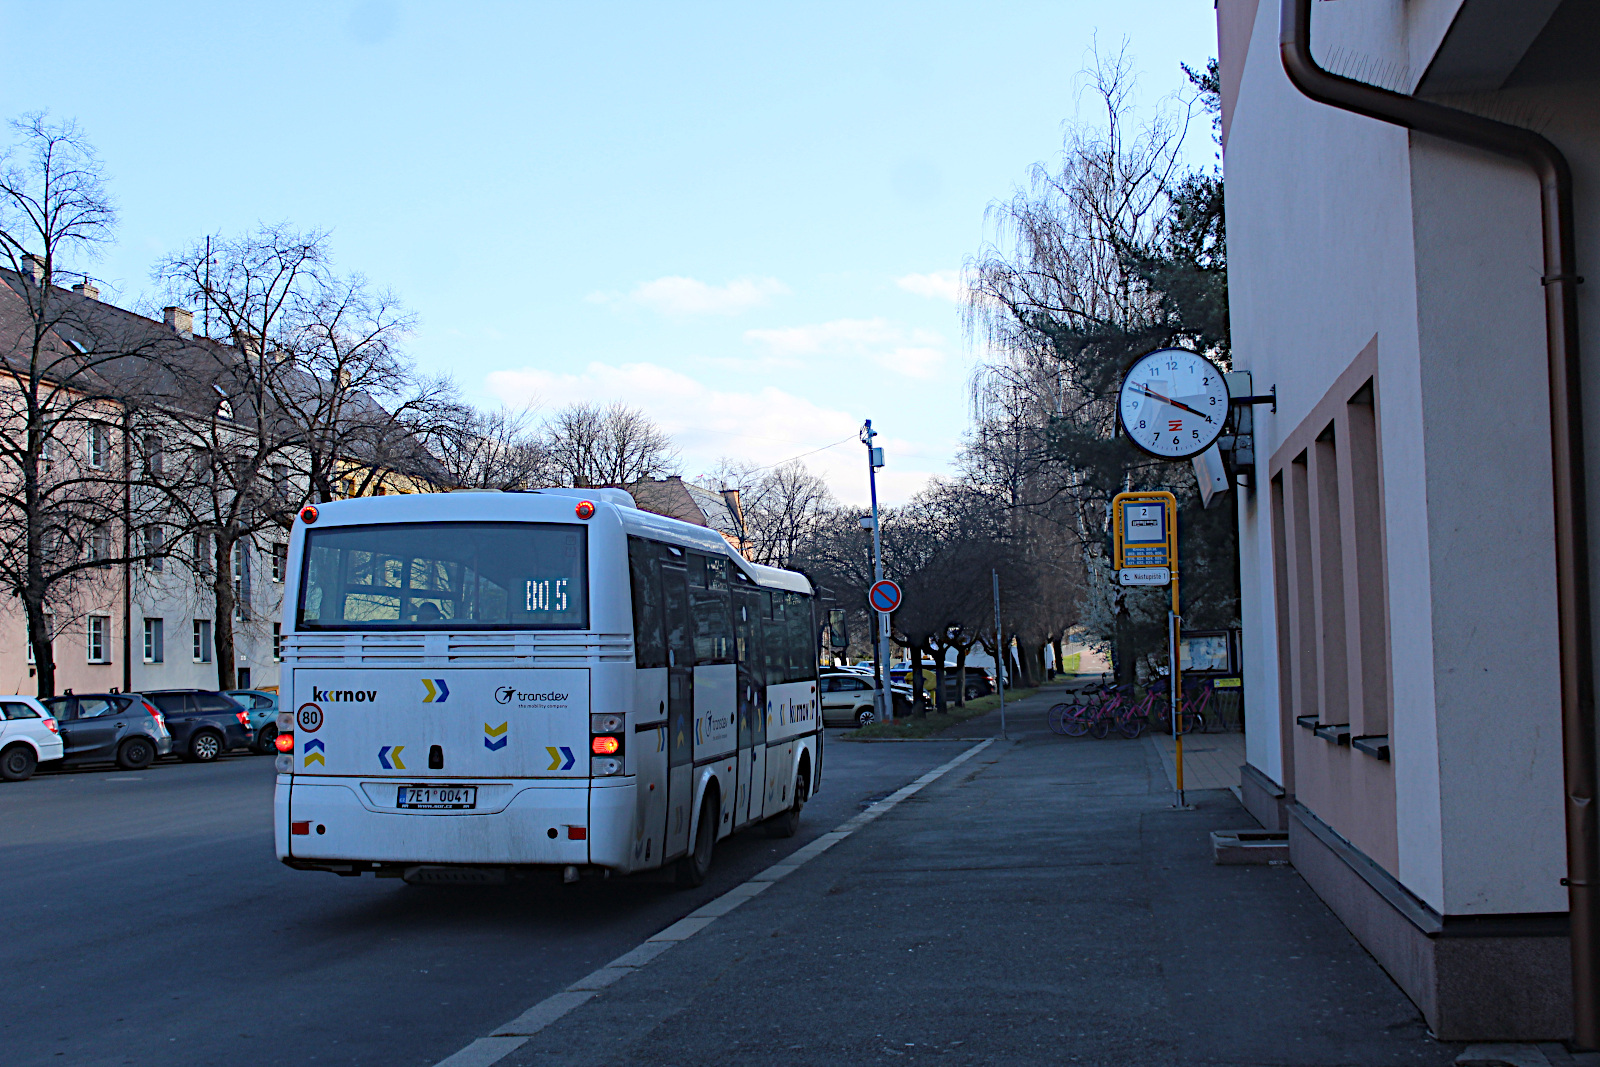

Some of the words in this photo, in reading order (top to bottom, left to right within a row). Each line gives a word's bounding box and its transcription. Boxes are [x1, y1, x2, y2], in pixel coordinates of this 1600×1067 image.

[1165, 361, 1178, 371] 12
[1188, 365, 1194, 374] 1
[1149, 367, 1159, 377] 11
[1202, 377, 1209, 386] 2
[1132, 400, 1138, 410] 9
[1209, 396, 1216, 405] 3
[1139, 419, 1146, 429] 8
[1205, 415, 1212, 424] 4
[1153, 432, 1160, 441] 7
[1192, 429, 1198, 439] 5
[1173, 435, 1179, 444] 6
[517, 691, 569, 701] transdev
[302, 711, 318, 725] 80
[409, 789, 430, 802] 7E1
[439, 789, 469, 802] 0041
